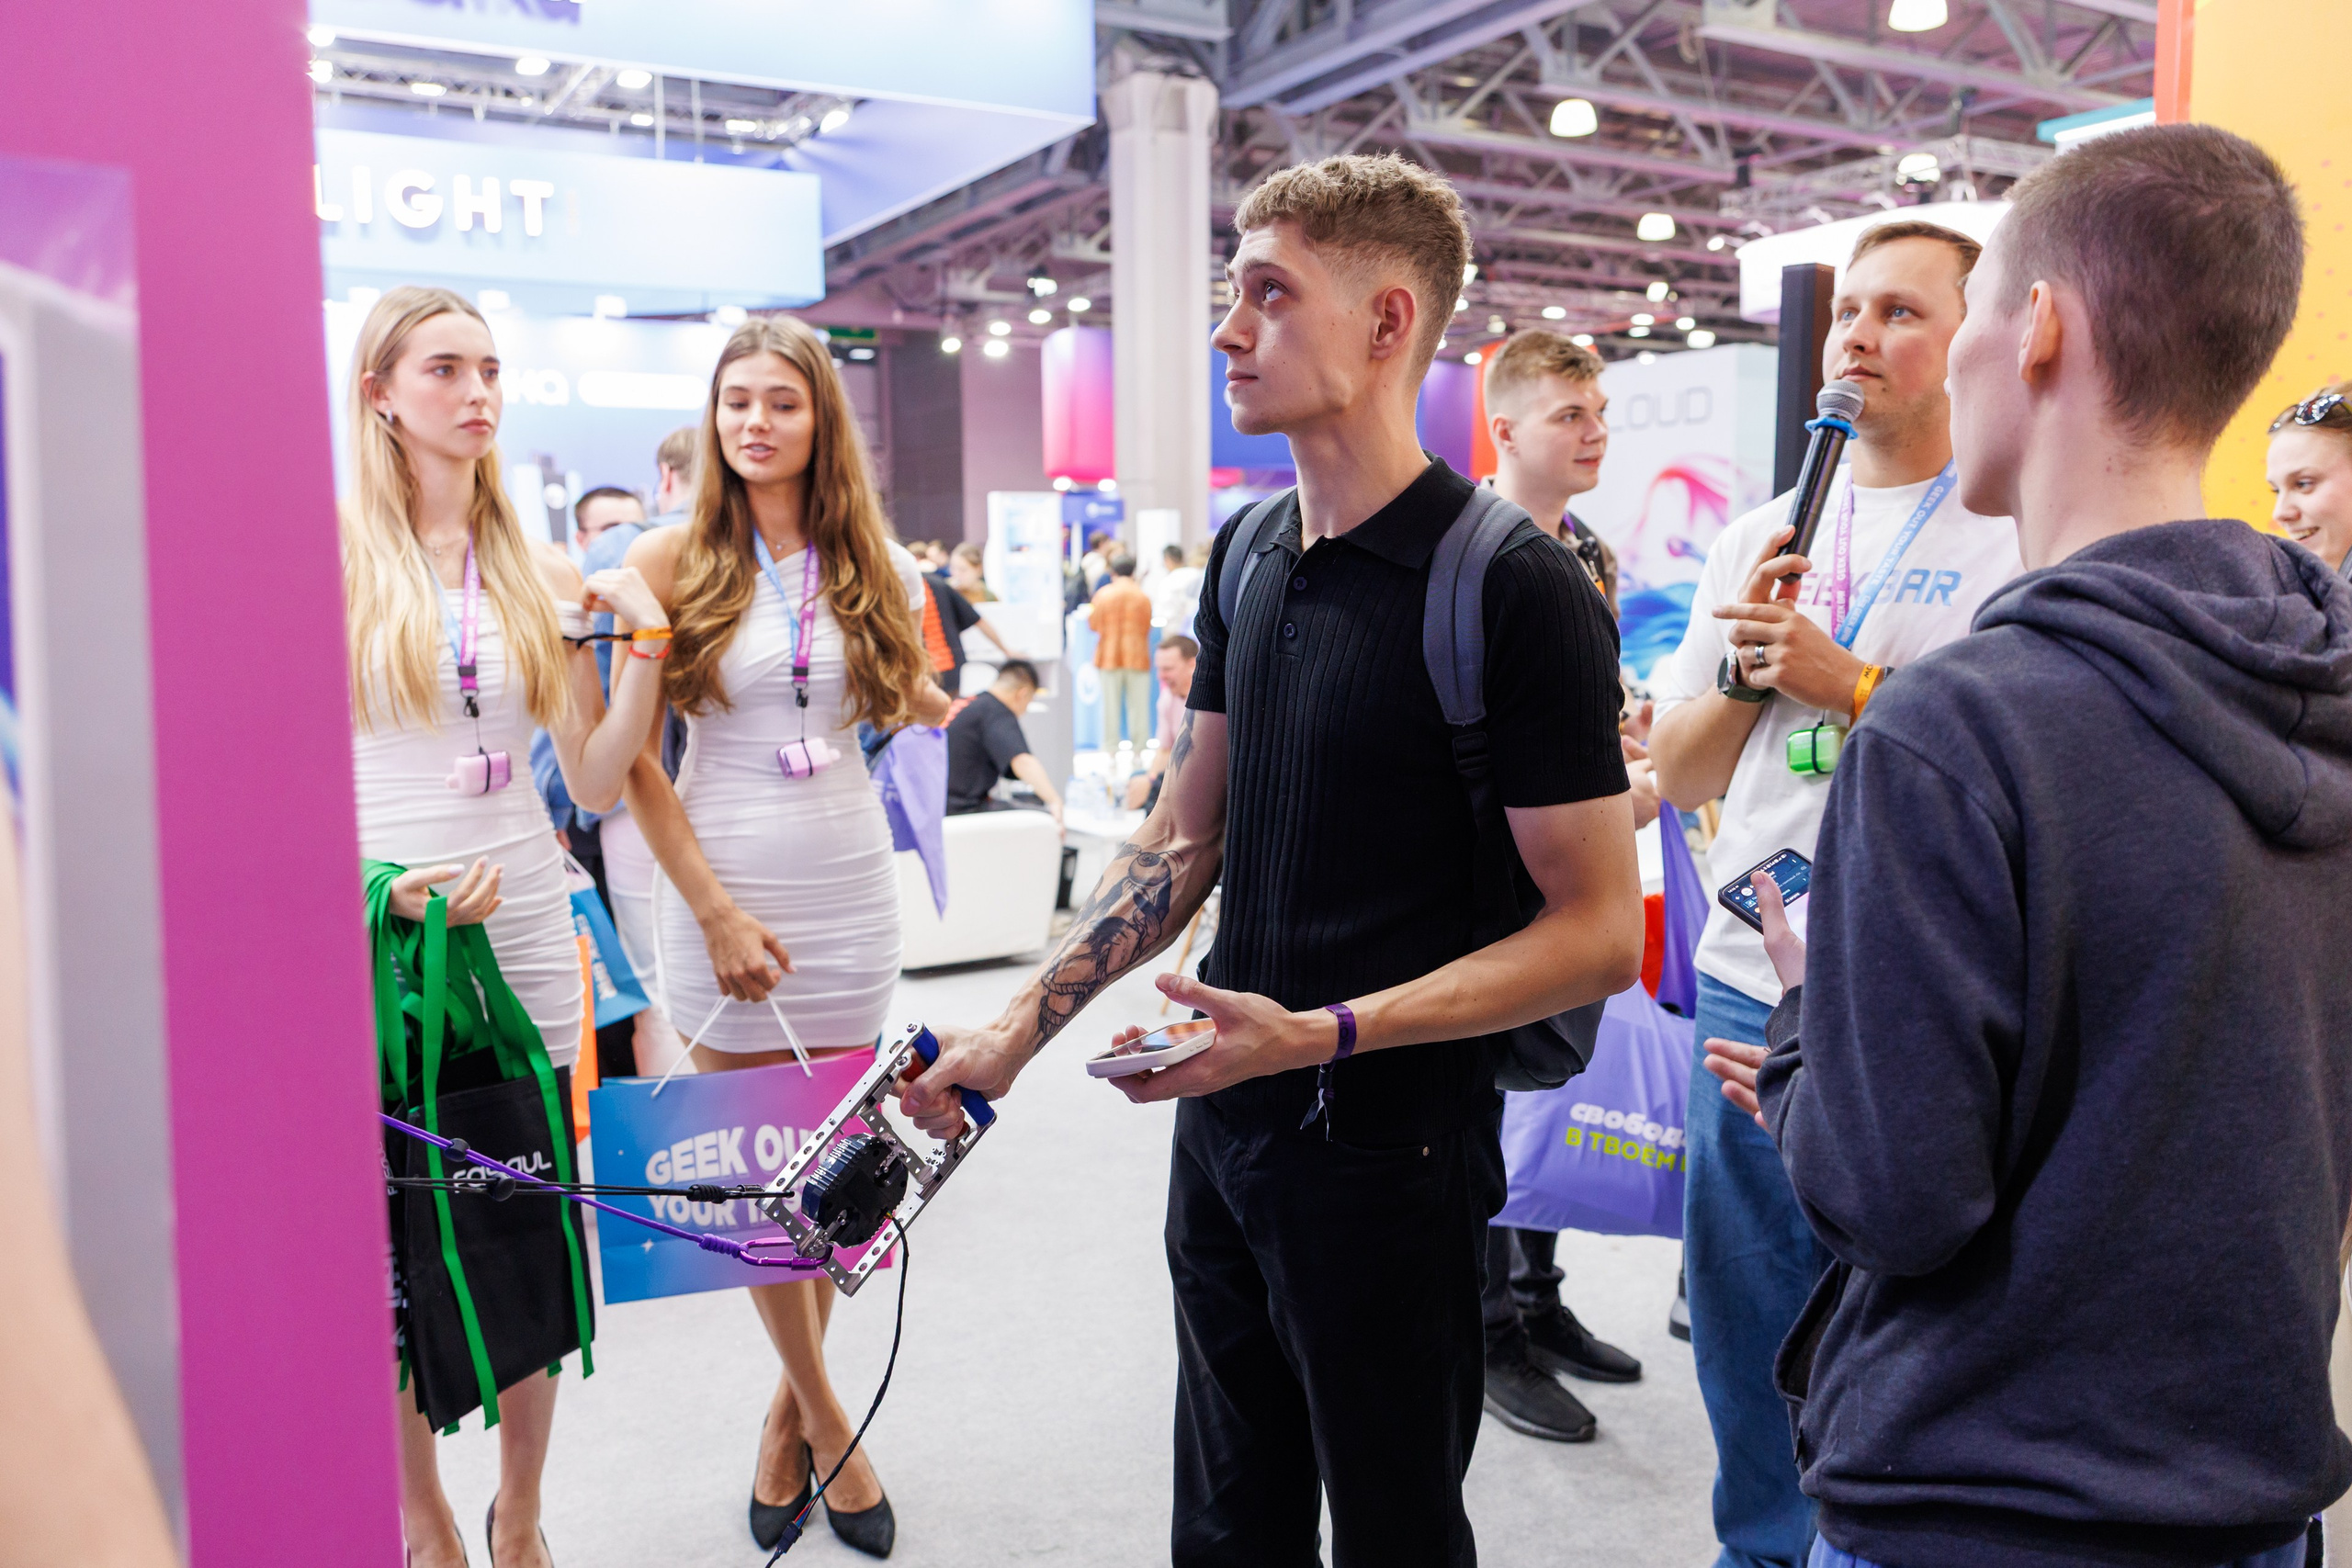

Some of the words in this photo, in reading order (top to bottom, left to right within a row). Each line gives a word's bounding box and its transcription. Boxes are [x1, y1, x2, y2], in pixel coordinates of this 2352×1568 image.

[312, 163, 554, 237] LIGHT
[1923, 485, 1944, 510] GEEK
[1908, 510, 1927, 530] OUT
[1838, 536, 1848, 556] OUT
[1890, 528, 1914, 557] YOUR
[1837, 557, 1847, 581] GEEK
[1871, 554, 1896, 587] TASTE
[645, 1126, 748, 1185] GEEK
[1565, 1126, 1582, 1147] В
[1589, 1131, 1677, 1172] ТВОЁМ
[644, 1189, 739, 1227] YOUR
